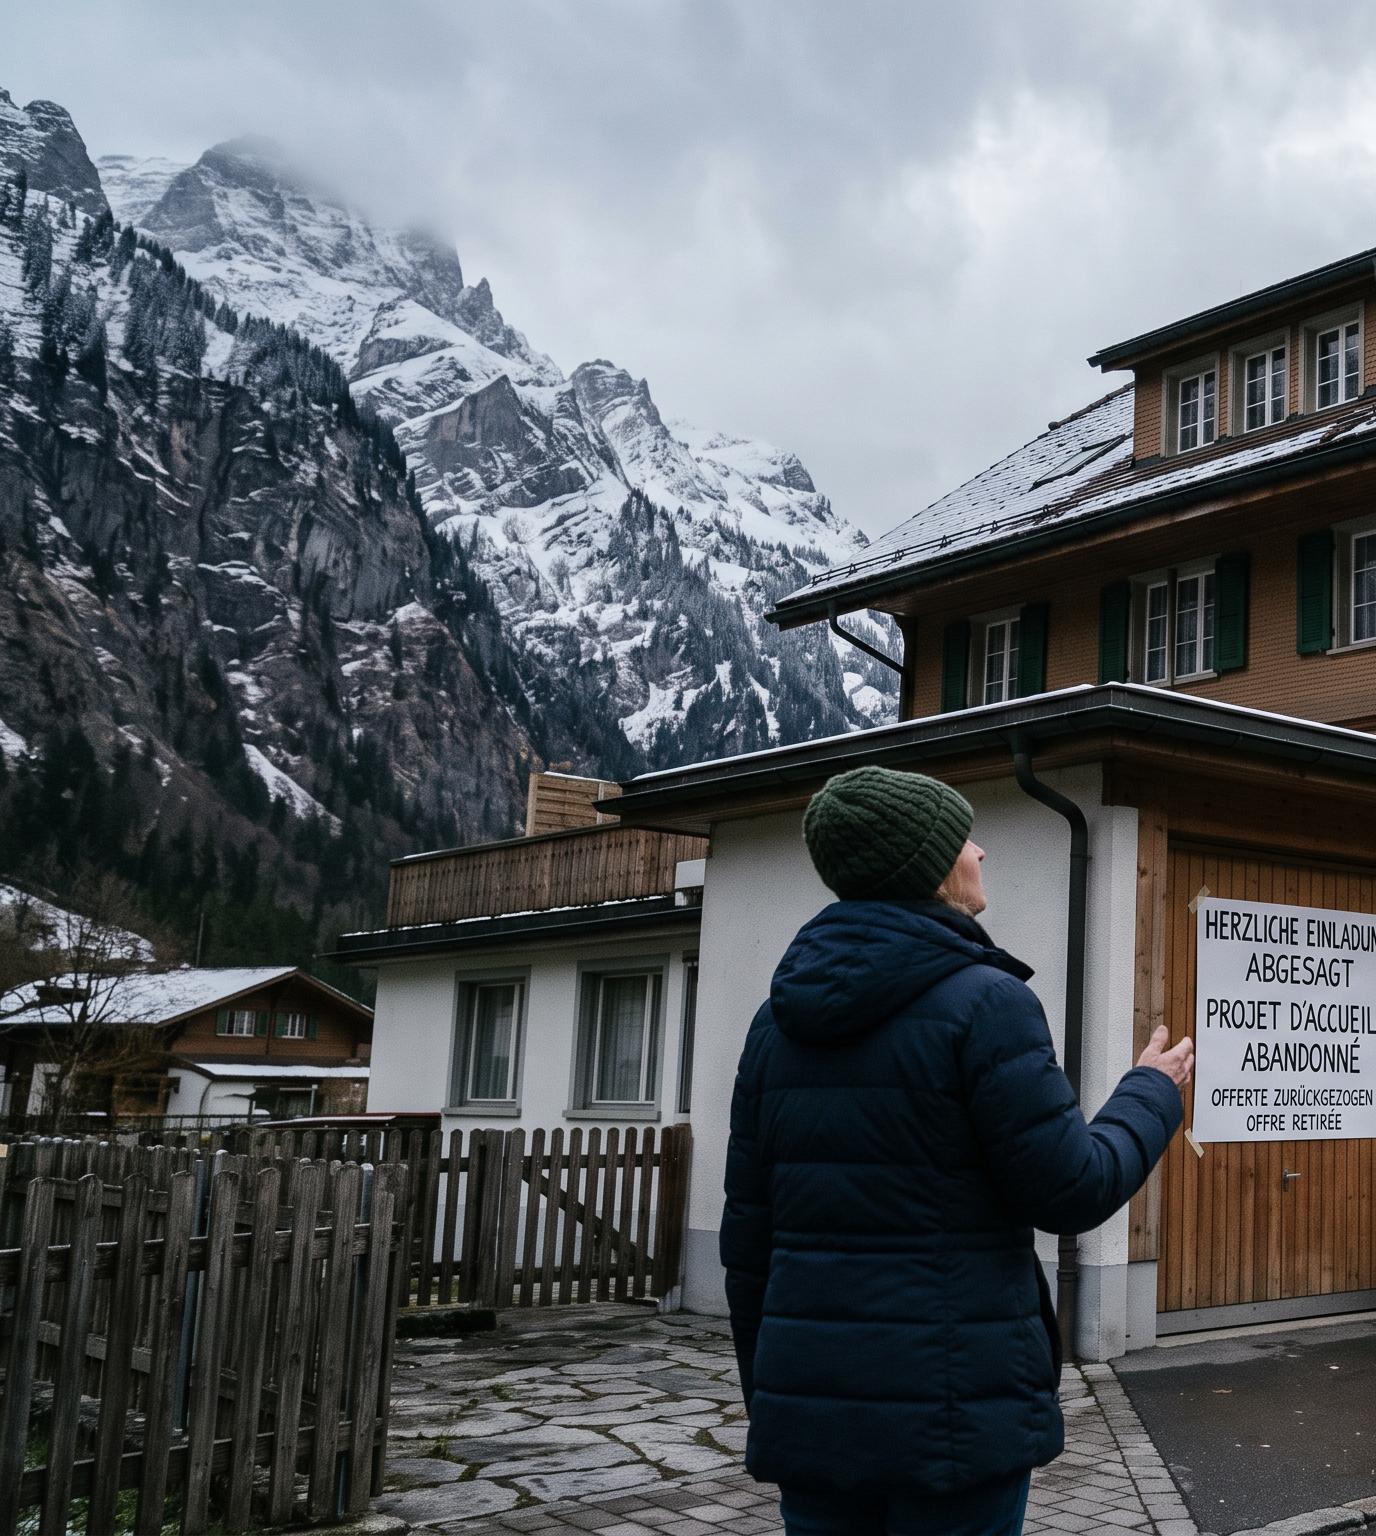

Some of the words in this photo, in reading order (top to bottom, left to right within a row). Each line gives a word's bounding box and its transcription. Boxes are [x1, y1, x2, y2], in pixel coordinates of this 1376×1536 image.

[1205, 909, 1299, 946] HERZLICHE
[1245, 953, 1354, 988] ABGESAGT
[1206, 998, 1281, 1030] PROJET
[1241, 1037, 1360, 1073] ABANDONNÉ
[1211, 1088, 1268, 1107] OFFERTE
[1273, 1085, 1373, 1106] ZURÜCKGEZOGEN
[1246, 1114, 1286, 1132] OFFRE
[1292, 1108, 1342, 1131] RETIRÉE
